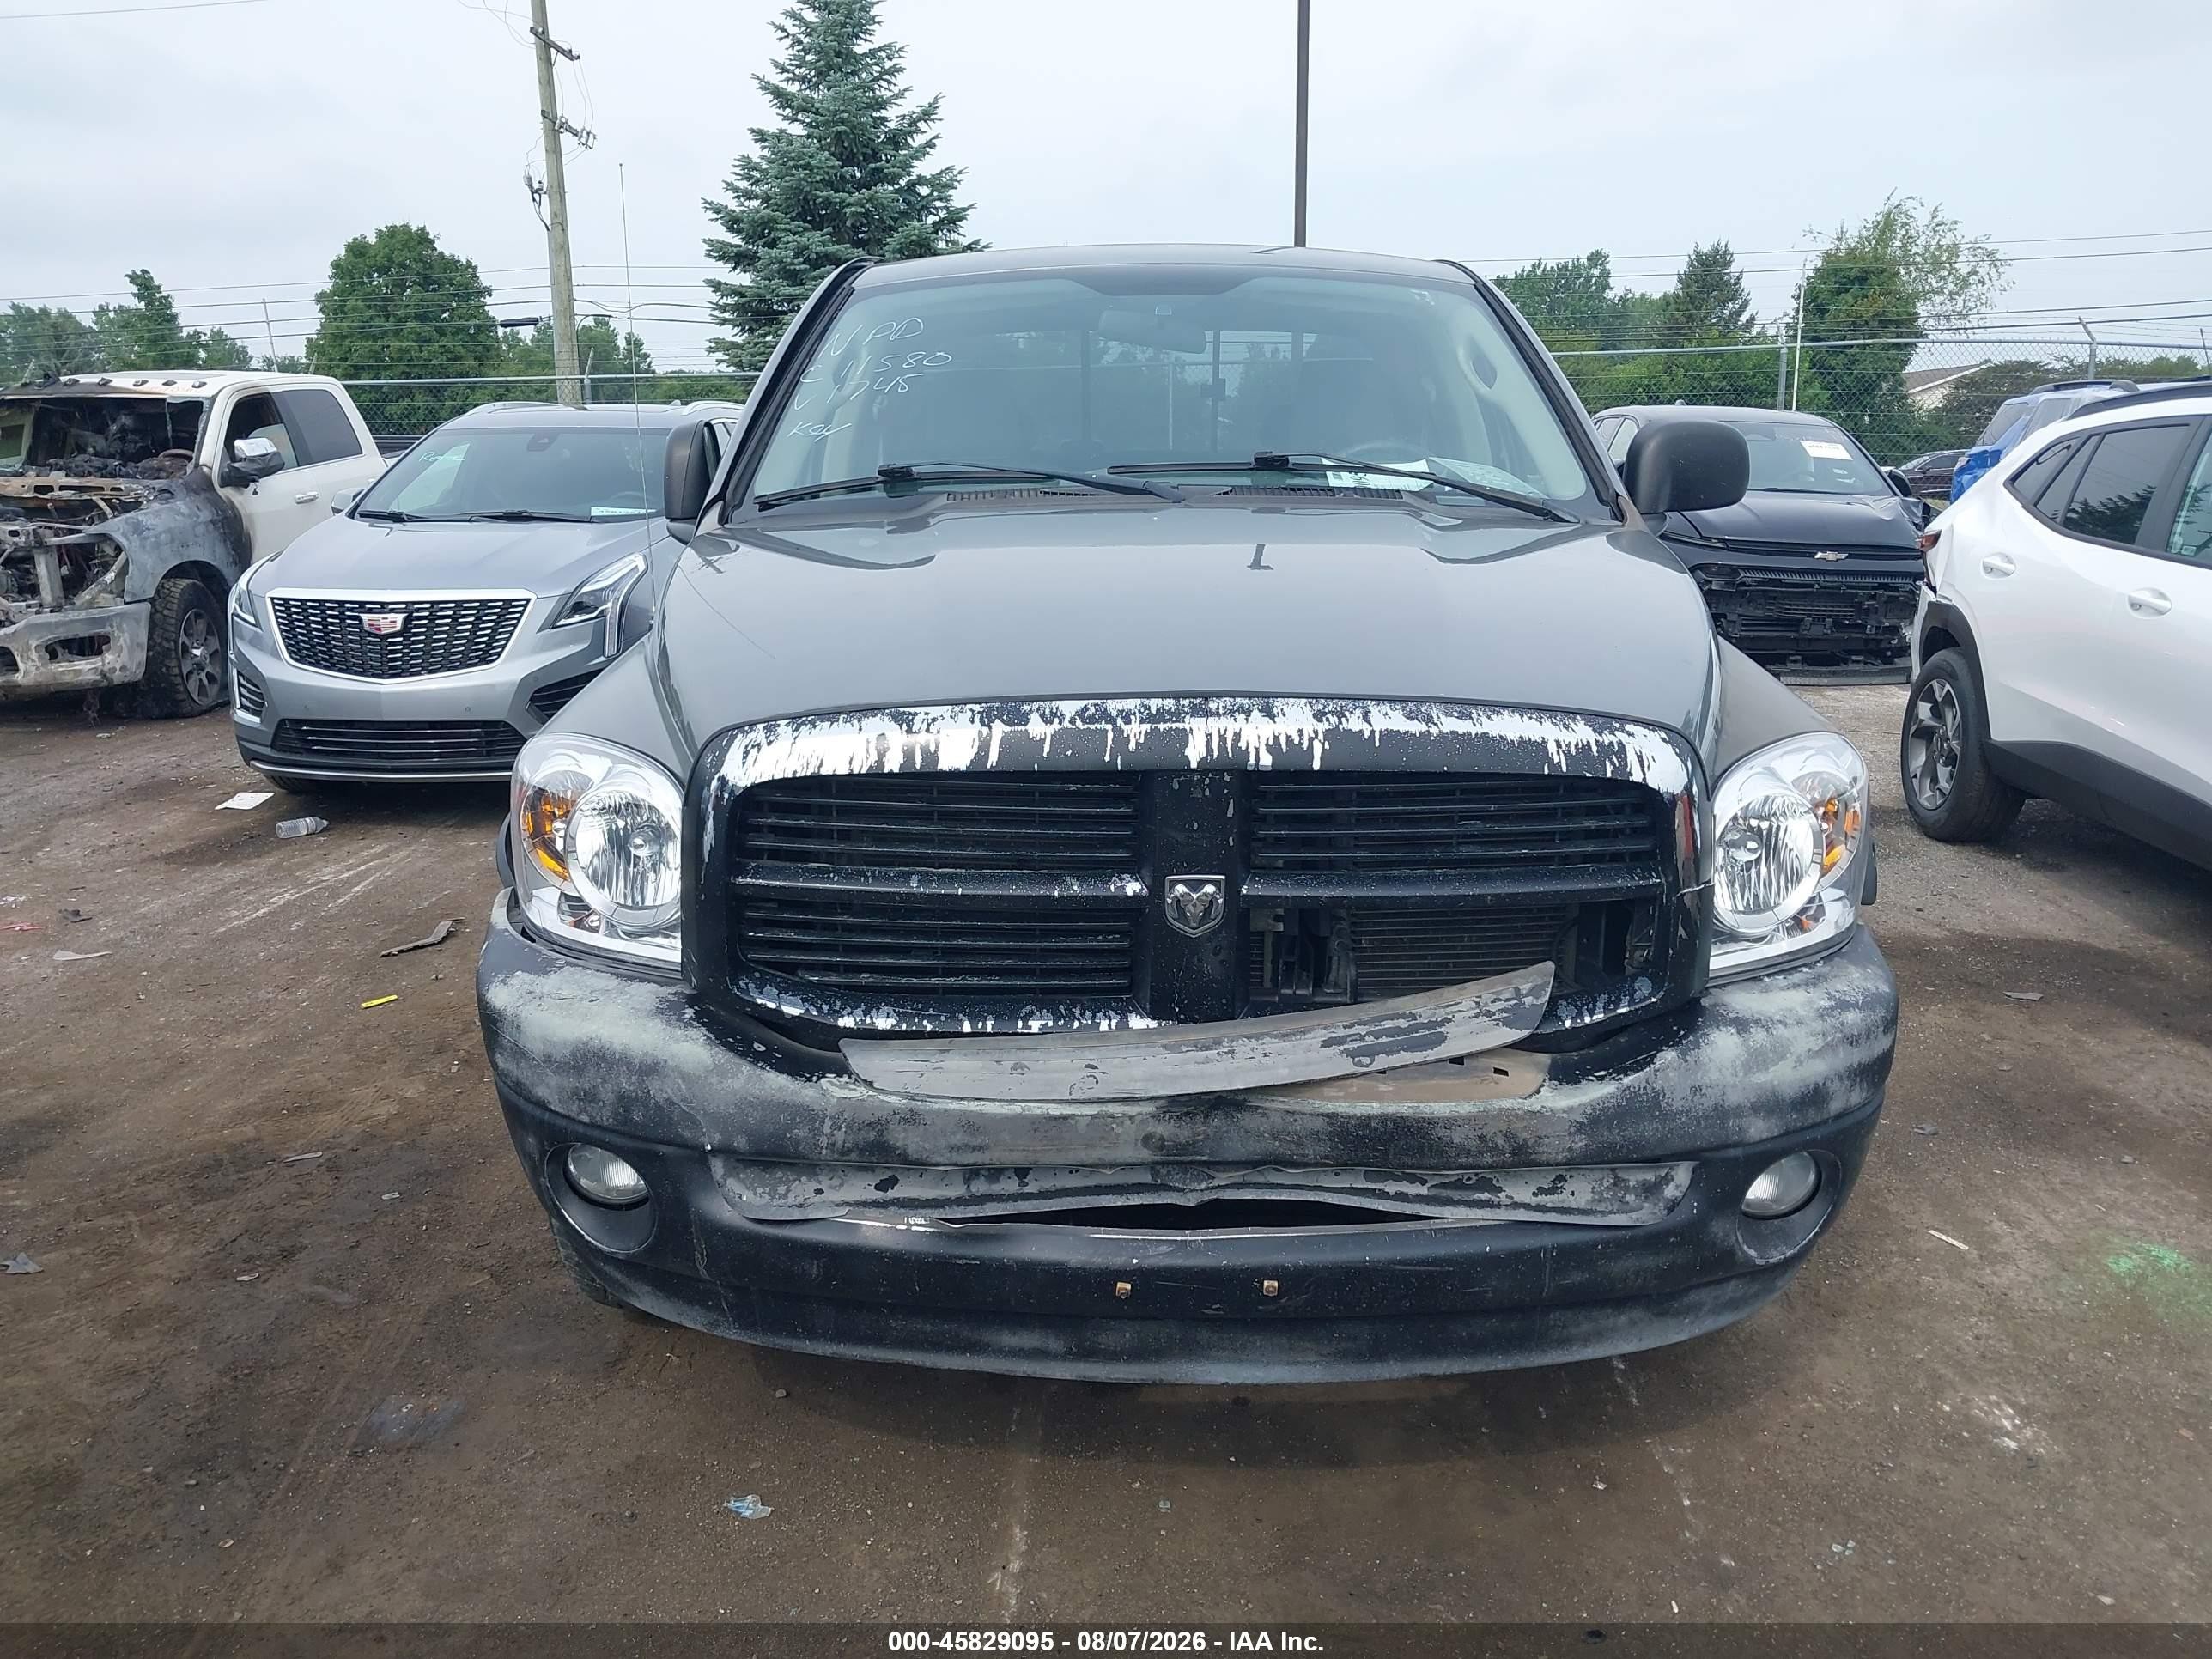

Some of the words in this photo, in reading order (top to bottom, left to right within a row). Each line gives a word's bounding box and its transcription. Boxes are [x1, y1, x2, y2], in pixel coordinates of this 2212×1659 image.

[817, 317, 924, 358] NPD
[840, 351, 953, 378] 11580
[826, 373, 925, 404] 1745
